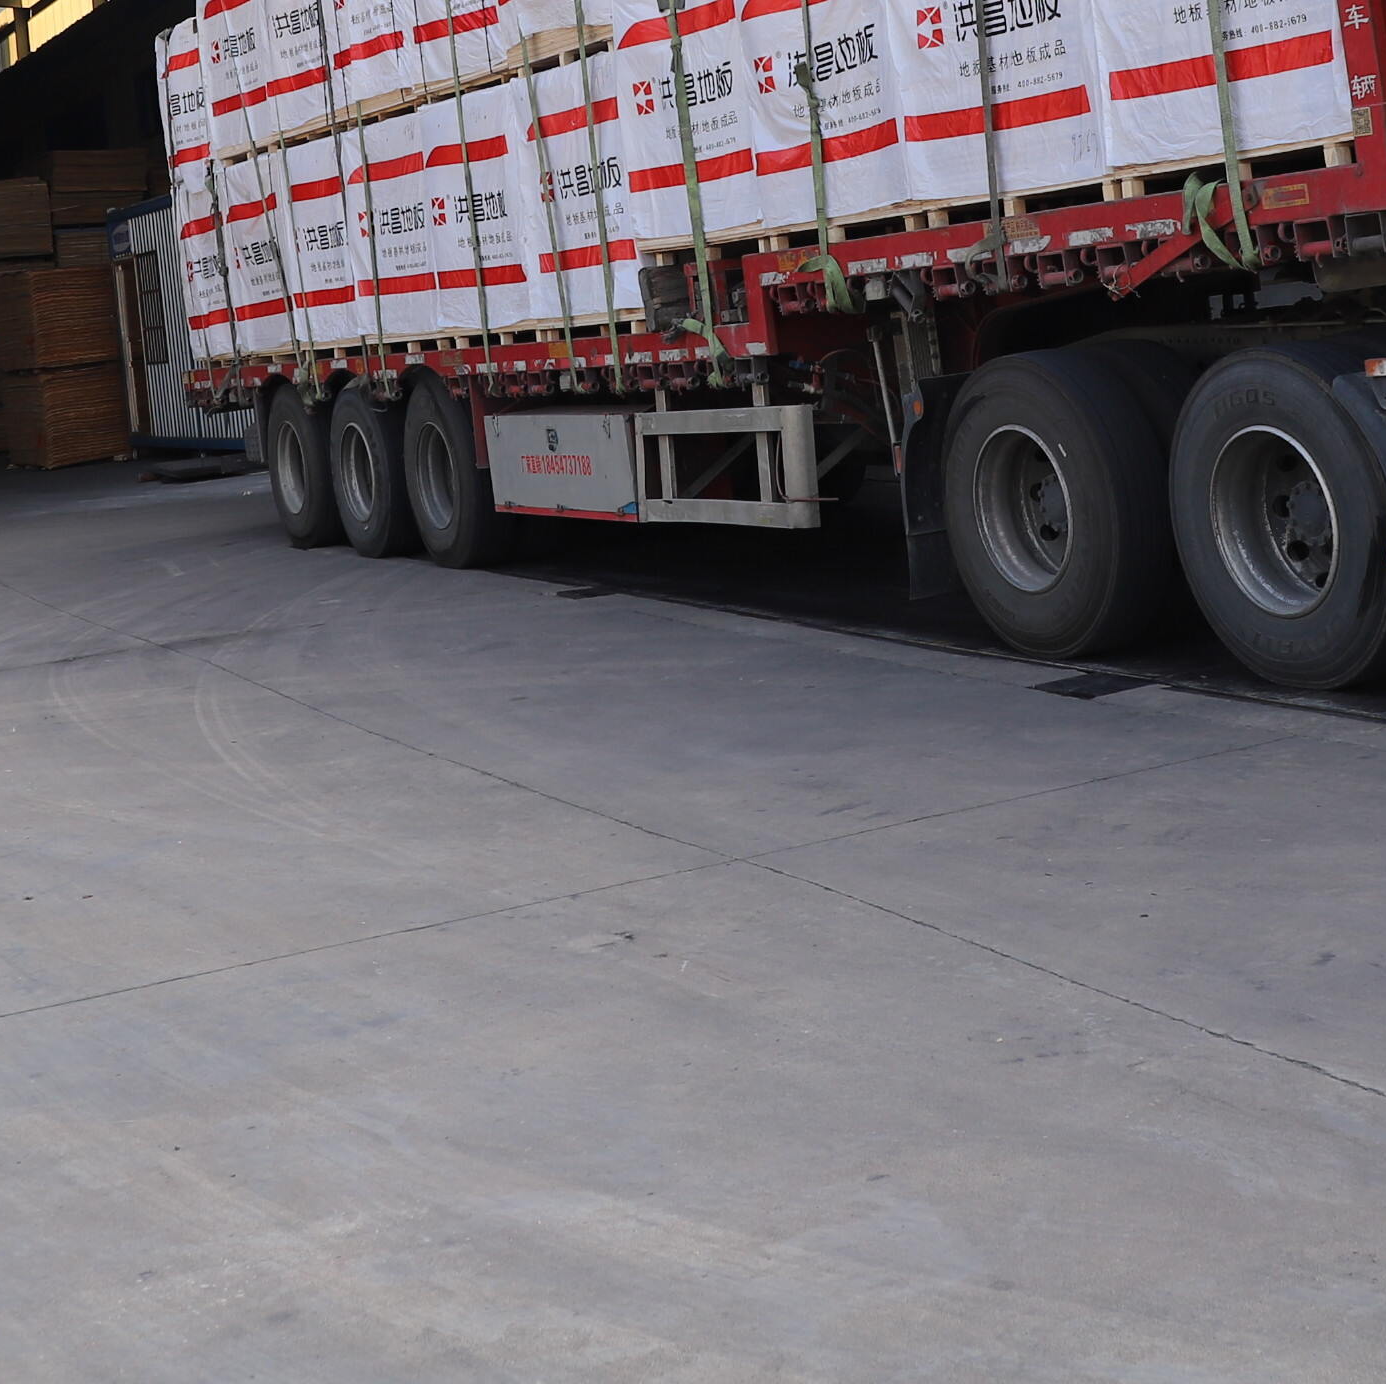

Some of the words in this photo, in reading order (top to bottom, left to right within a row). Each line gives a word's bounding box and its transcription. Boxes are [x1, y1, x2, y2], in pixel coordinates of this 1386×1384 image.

[658, 61, 733, 111] 洪昌地板
[1017, 71, 1063, 88] 400-882-5679
[379, 202, 426, 236] 洪昌地板
